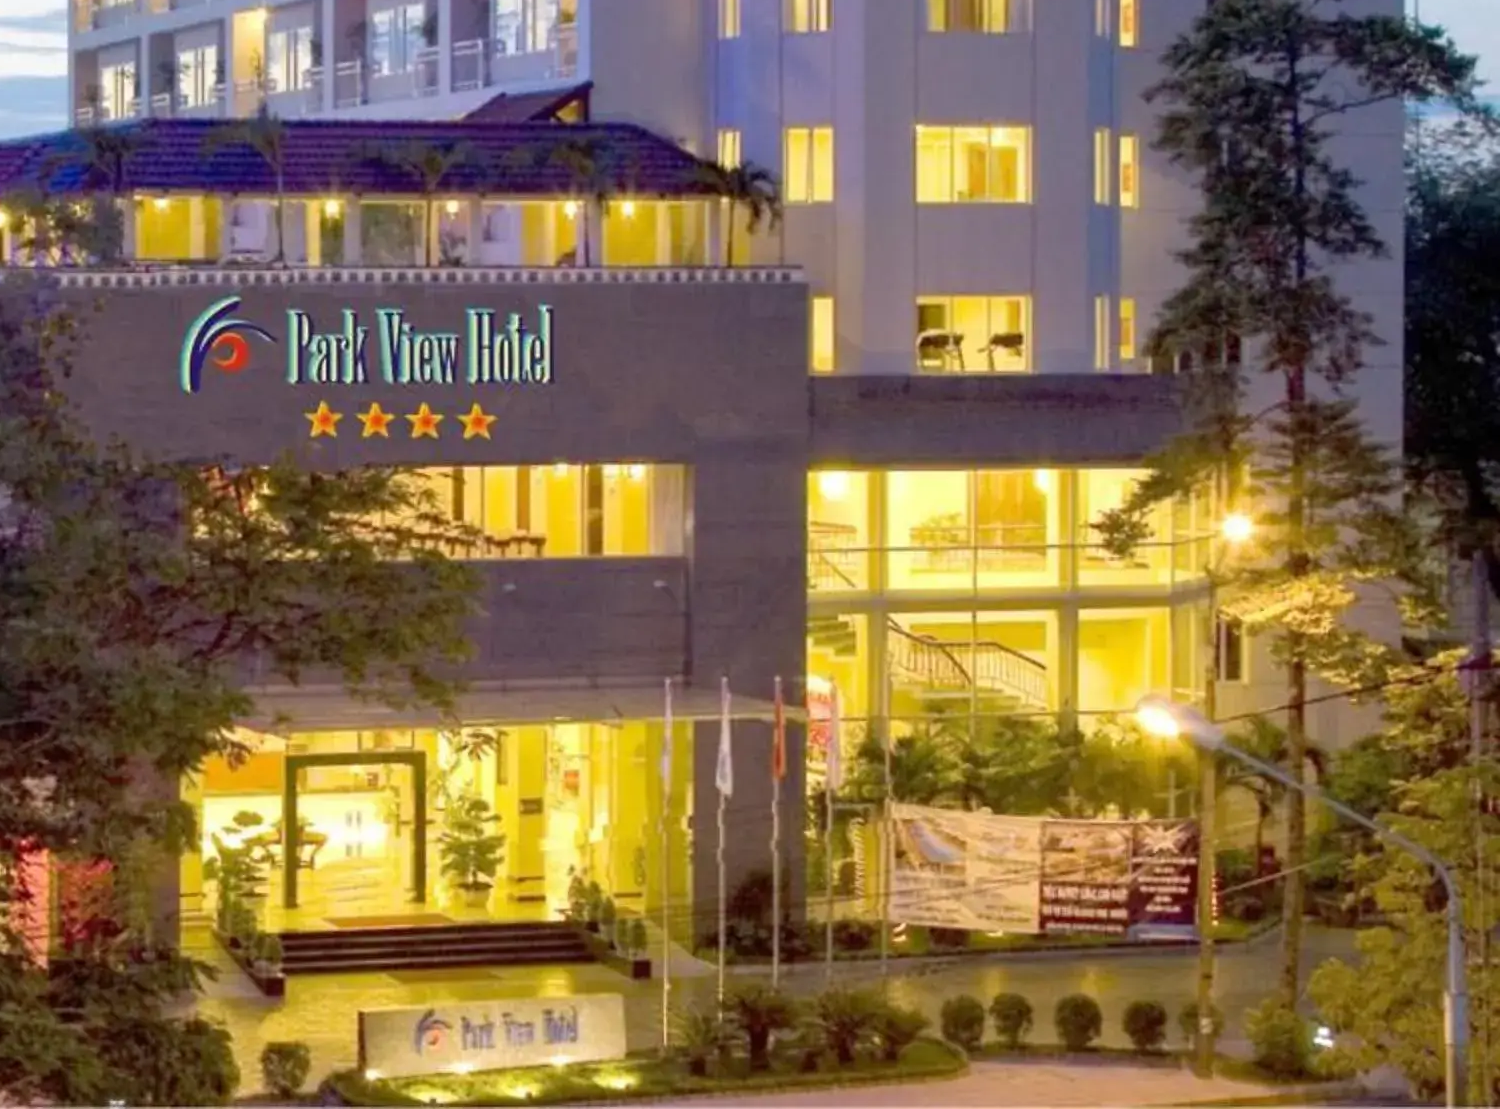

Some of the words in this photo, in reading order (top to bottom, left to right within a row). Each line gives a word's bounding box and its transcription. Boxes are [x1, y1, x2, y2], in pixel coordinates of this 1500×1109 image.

[286, 306, 370, 385] Park
[376, 308, 459, 385] View
[465, 304, 556, 385] Hotel
